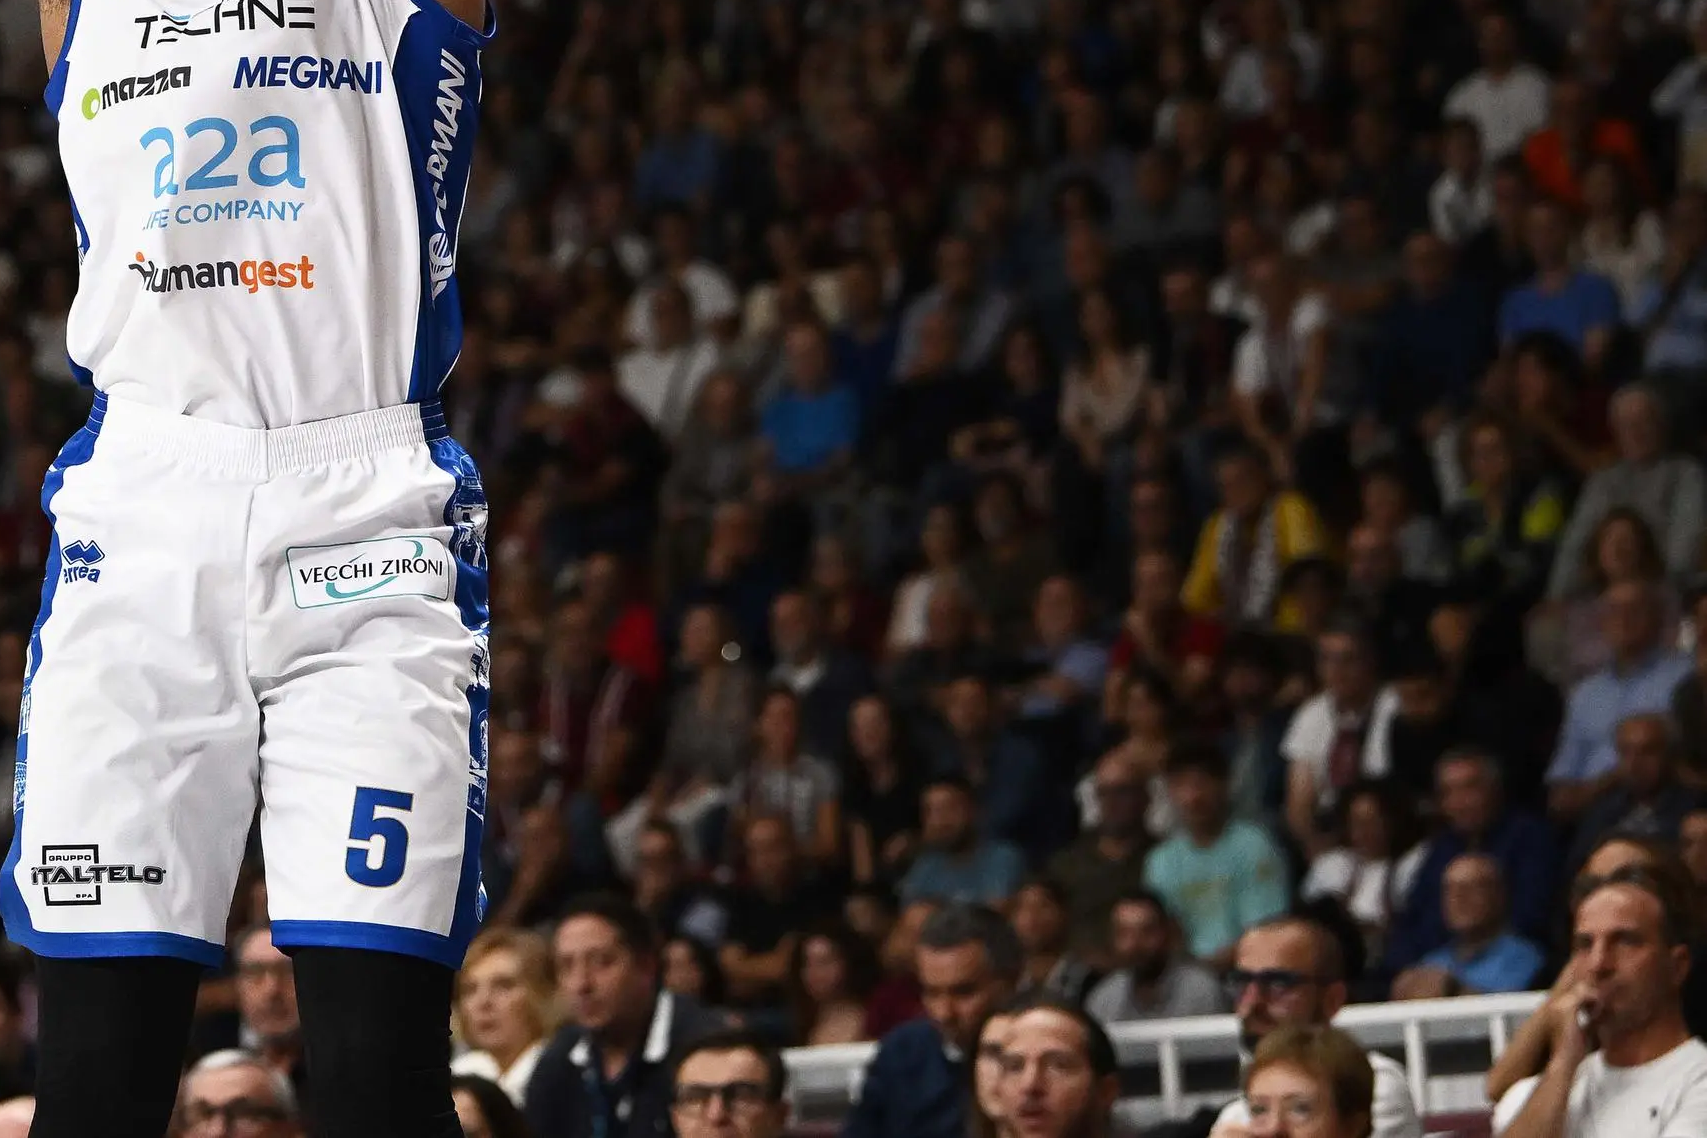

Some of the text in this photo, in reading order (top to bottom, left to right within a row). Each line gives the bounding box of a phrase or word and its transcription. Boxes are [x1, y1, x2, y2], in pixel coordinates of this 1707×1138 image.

[232, 55, 383, 94] MEGRANI
[139, 115, 306, 200] a2a
[142, 199, 305, 231] IFE COMPANY
[299, 557, 443, 584] VECCHI ZIRONI
[345, 785, 414, 888] 5
[48, 854, 92, 862] GRUPPO
